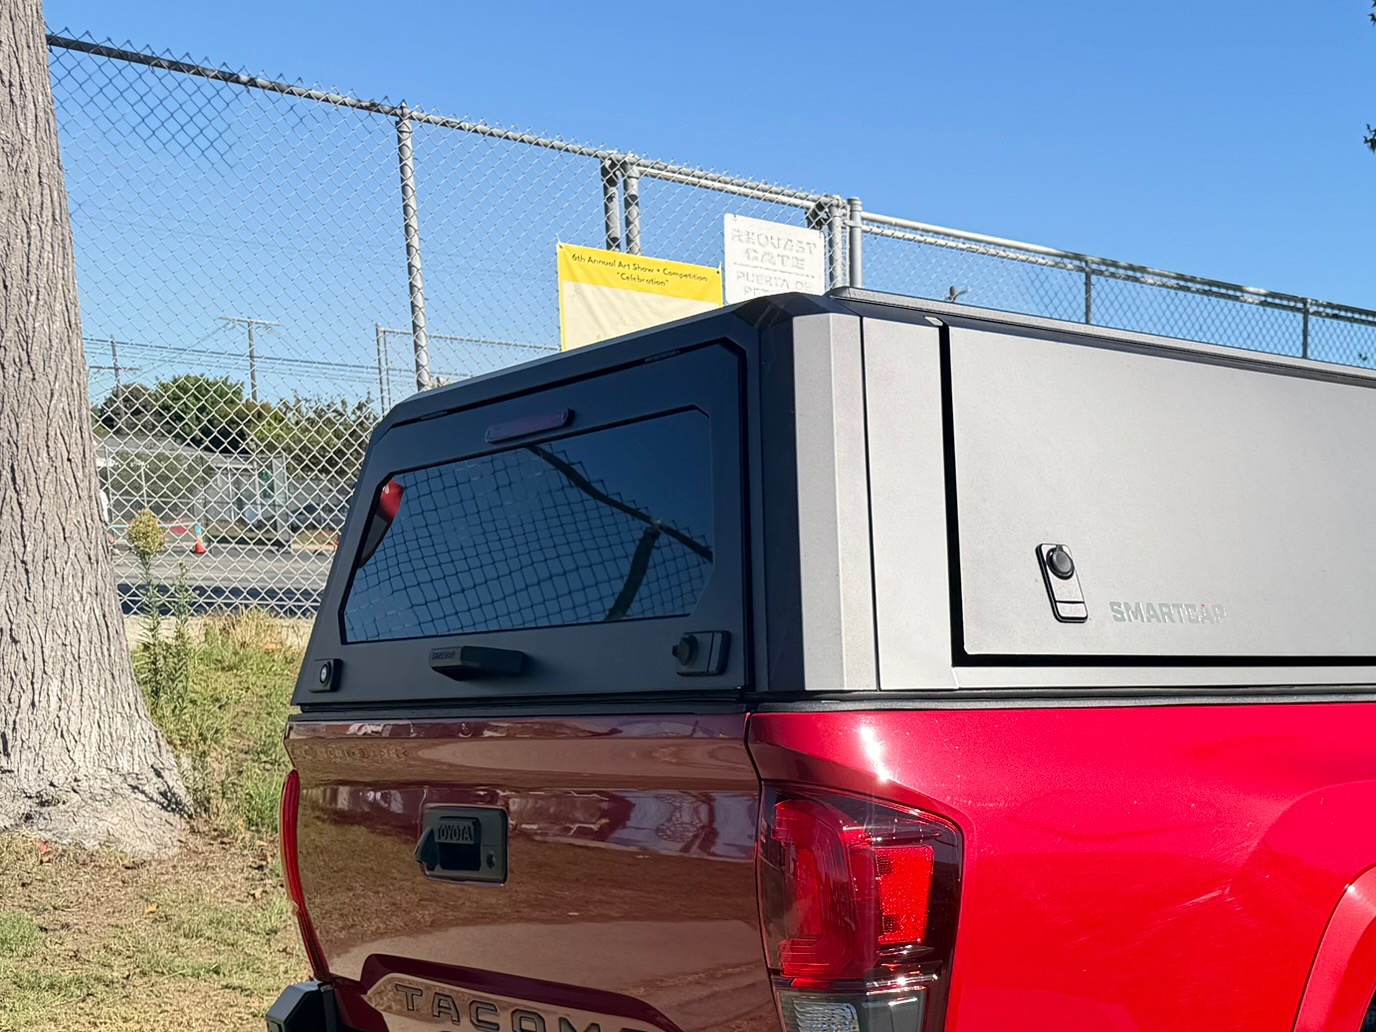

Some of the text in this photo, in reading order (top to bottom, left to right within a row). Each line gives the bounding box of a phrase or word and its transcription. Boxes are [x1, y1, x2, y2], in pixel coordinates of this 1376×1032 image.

[572, 253, 708, 282] 6th Annual Art Show Competition
[1109, 601, 1228, 624] SMARTCAP
